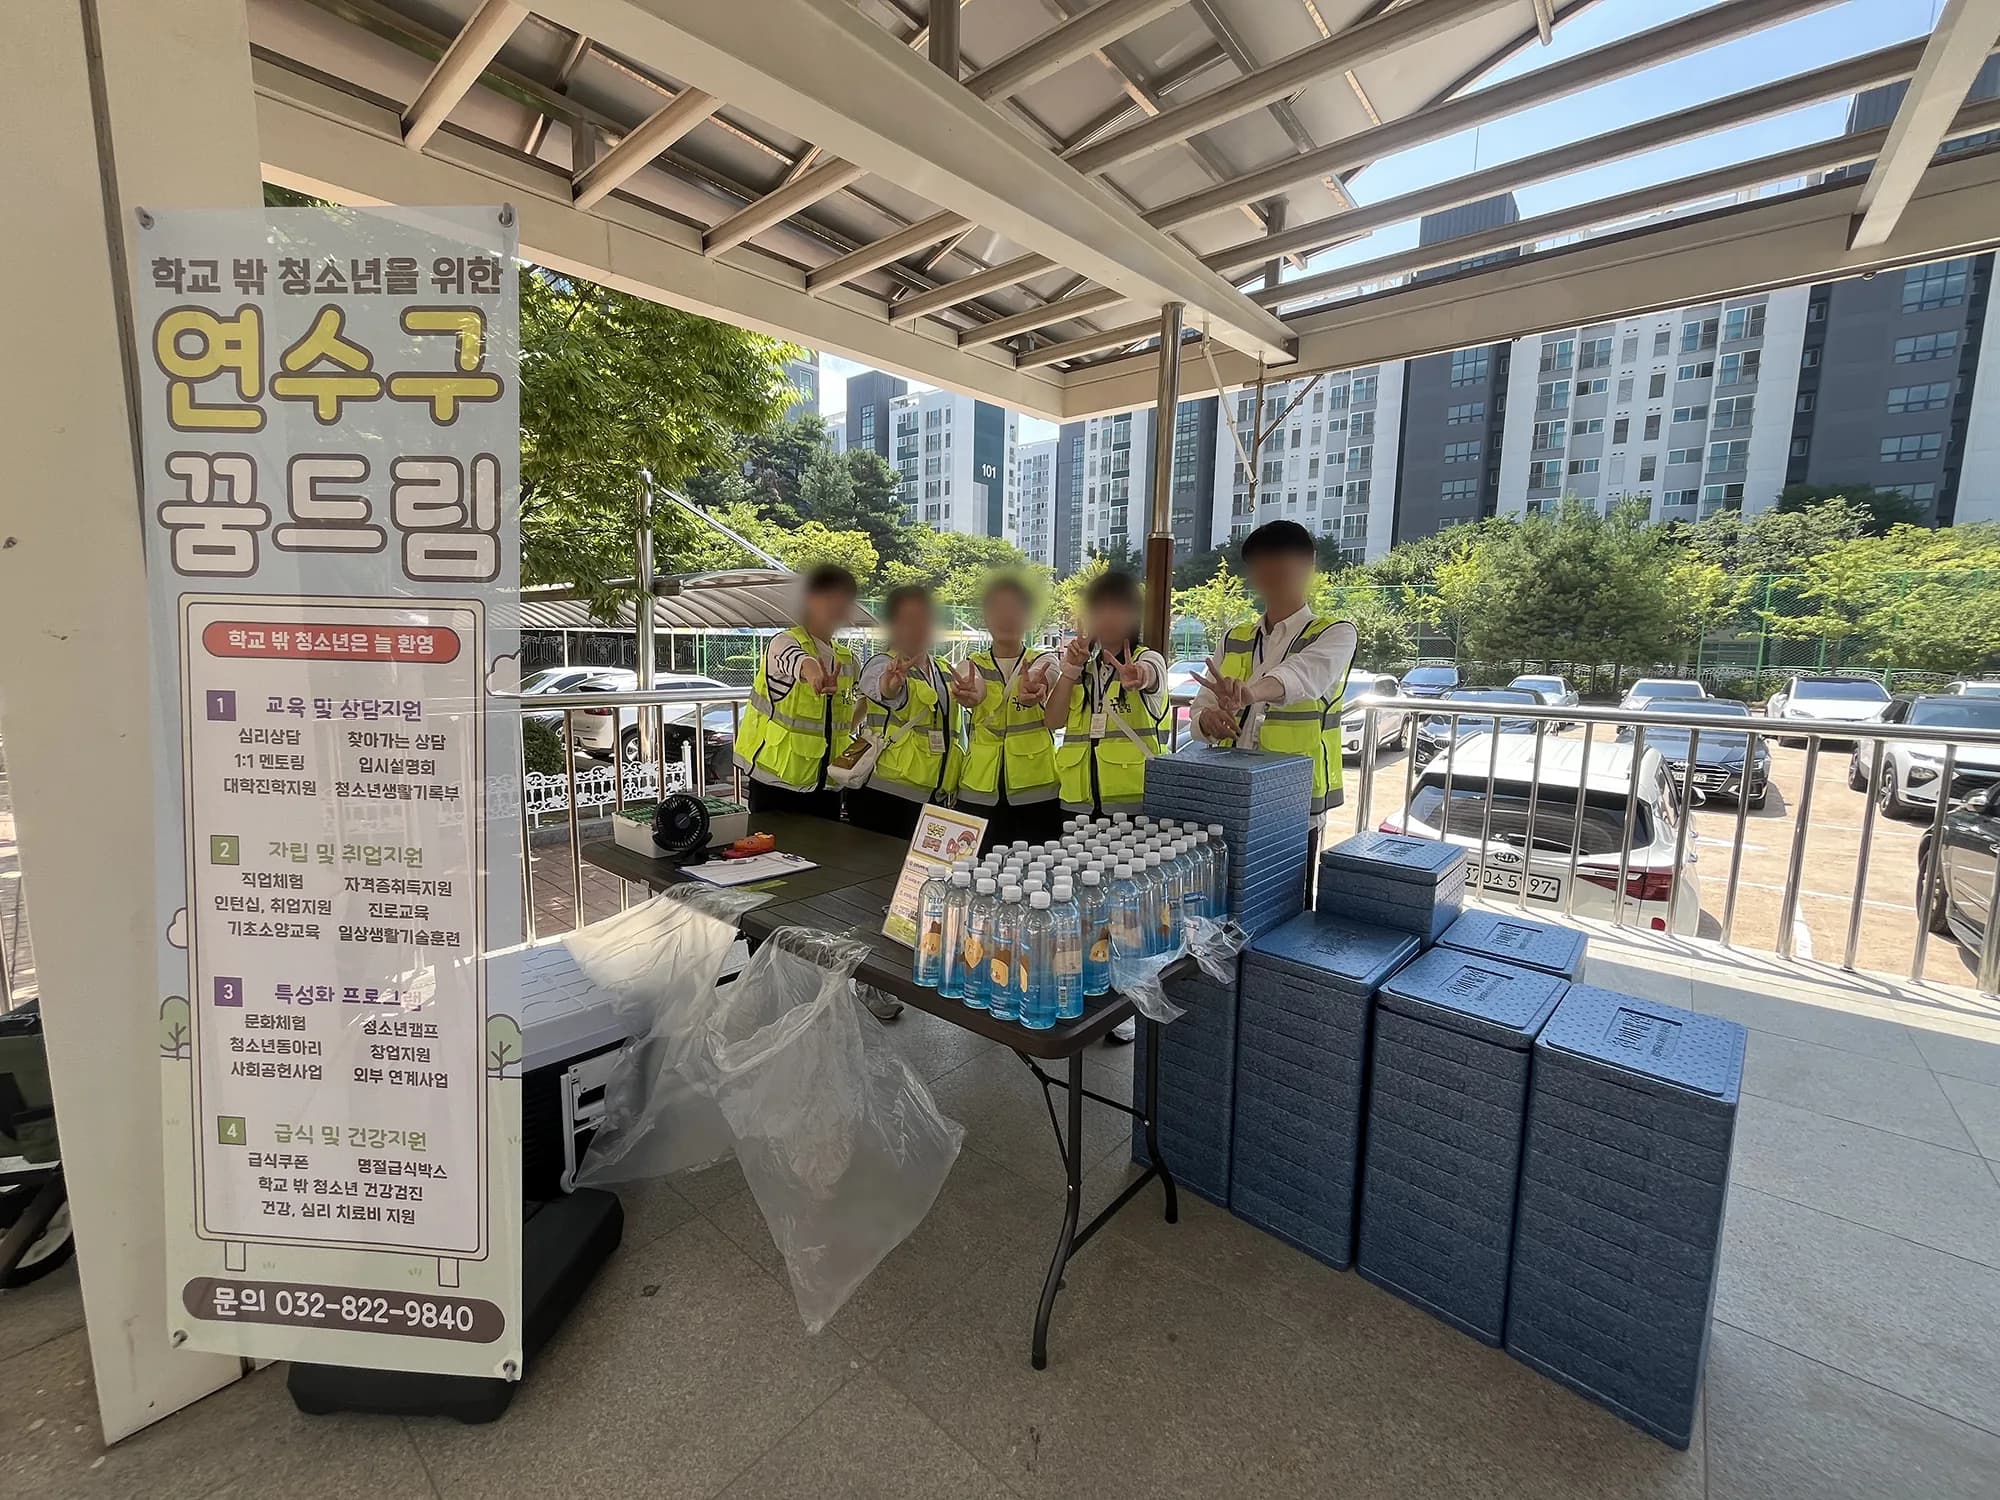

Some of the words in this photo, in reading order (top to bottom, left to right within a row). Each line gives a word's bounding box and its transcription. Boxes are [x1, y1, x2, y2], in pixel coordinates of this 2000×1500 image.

[152, 257, 221, 295] 학교
[232, 257, 268, 296] 밖
[278, 256, 420, 296] 청소년을
[430, 255, 504, 295] 위한
[152, 303, 505, 434] 연수구
[982, 464, 996, 479] 101
[156, 450, 501, 583] 꿈드림
[228, 630, 265, 650] 학교
[271, 631, 291, 652] 밖
[295, 631, 369, 654] 청소년은
[374, 634, 393, 654] 늘
[397, 634, 434, 655] 환영
[217, 697, 224, 713] 1
[266, 696, 306, 718] 교육
[313, 698, 332, 720] 및
[340, 698, 422, 722] 상담지원
[238, 728, 301, 746] 심리상담
[347, 731, 410, 751] 찾아가는
[414, 732, 446, 751] 상담
[234, 753, 255, 769] 1:1
[258, 754, 305, 771] 멘토링
[358, 757, 436, 777] 입시설명회
[223, 778, 317, 797] 대학진학지원
[335, 781, 460, 802] 청소년생활기록부
[220, 842, 230, 858] 2
[268, 841, 308, 864] 자립
[316, 843, 335, 864] 및
[342, 845, 424, 868] 취업지원
[1496, 852, 1517, 862] KIA
[241, 872, 304, 890] 직업체험
[344, 876, 452, 897] 자격증취득지원
[1508, 875, 1551, 894] 597
[214, 896, 266, 914] 인턴십,
[270, 898, 332, 916] 취업지원
[368, 903, 430, 921] 진로교육
[227, 920, 321, 939] 기초소양교육
[338, 925, 461, 947] 일상생활기술훈련
[223, 984, 234, 1000] 3
[274, 982, 335, 1006] 특성화
[244, 1013, 307, 1032] 문화체험
[229, 1037, 322, 1057] 청소년동아리
[369, 1043, 431, 1063] 창업지원
[230, 1061, 323, 1081] 사회공헌사업
[353, 1067, 384, 1085] 외부
[388, 1068, 449, 1089] 연계사업
[226, 1123, 237, 1139] 4
[273, 1123, 314, 1144] 급식
[321, 1125, 340, 1146] 및
[347, 1126, 427, 1152] 건강지원
[247, 1152, 309, 1171] 급식쿠폰
[357, 1158, 447, 1180] 명절급식박스
[258, 1176, 288, 1194] 학교
[292, 1177, 308, 1195] 밖
[313, 1178, 359, 1197] 청소년
[363, 1181, 423, 1201] 건강검진
[262, 1200, 296, 1219] 건강,
[301, 1202, 331, 1220] 심리
[336, 1203, 382, 1222] 치료비
[386, 1206, 416, 1225] 지원
[213, 1287, 266, 1316] 문의
[274, 1288, 474, 1332] 032-822-9840
